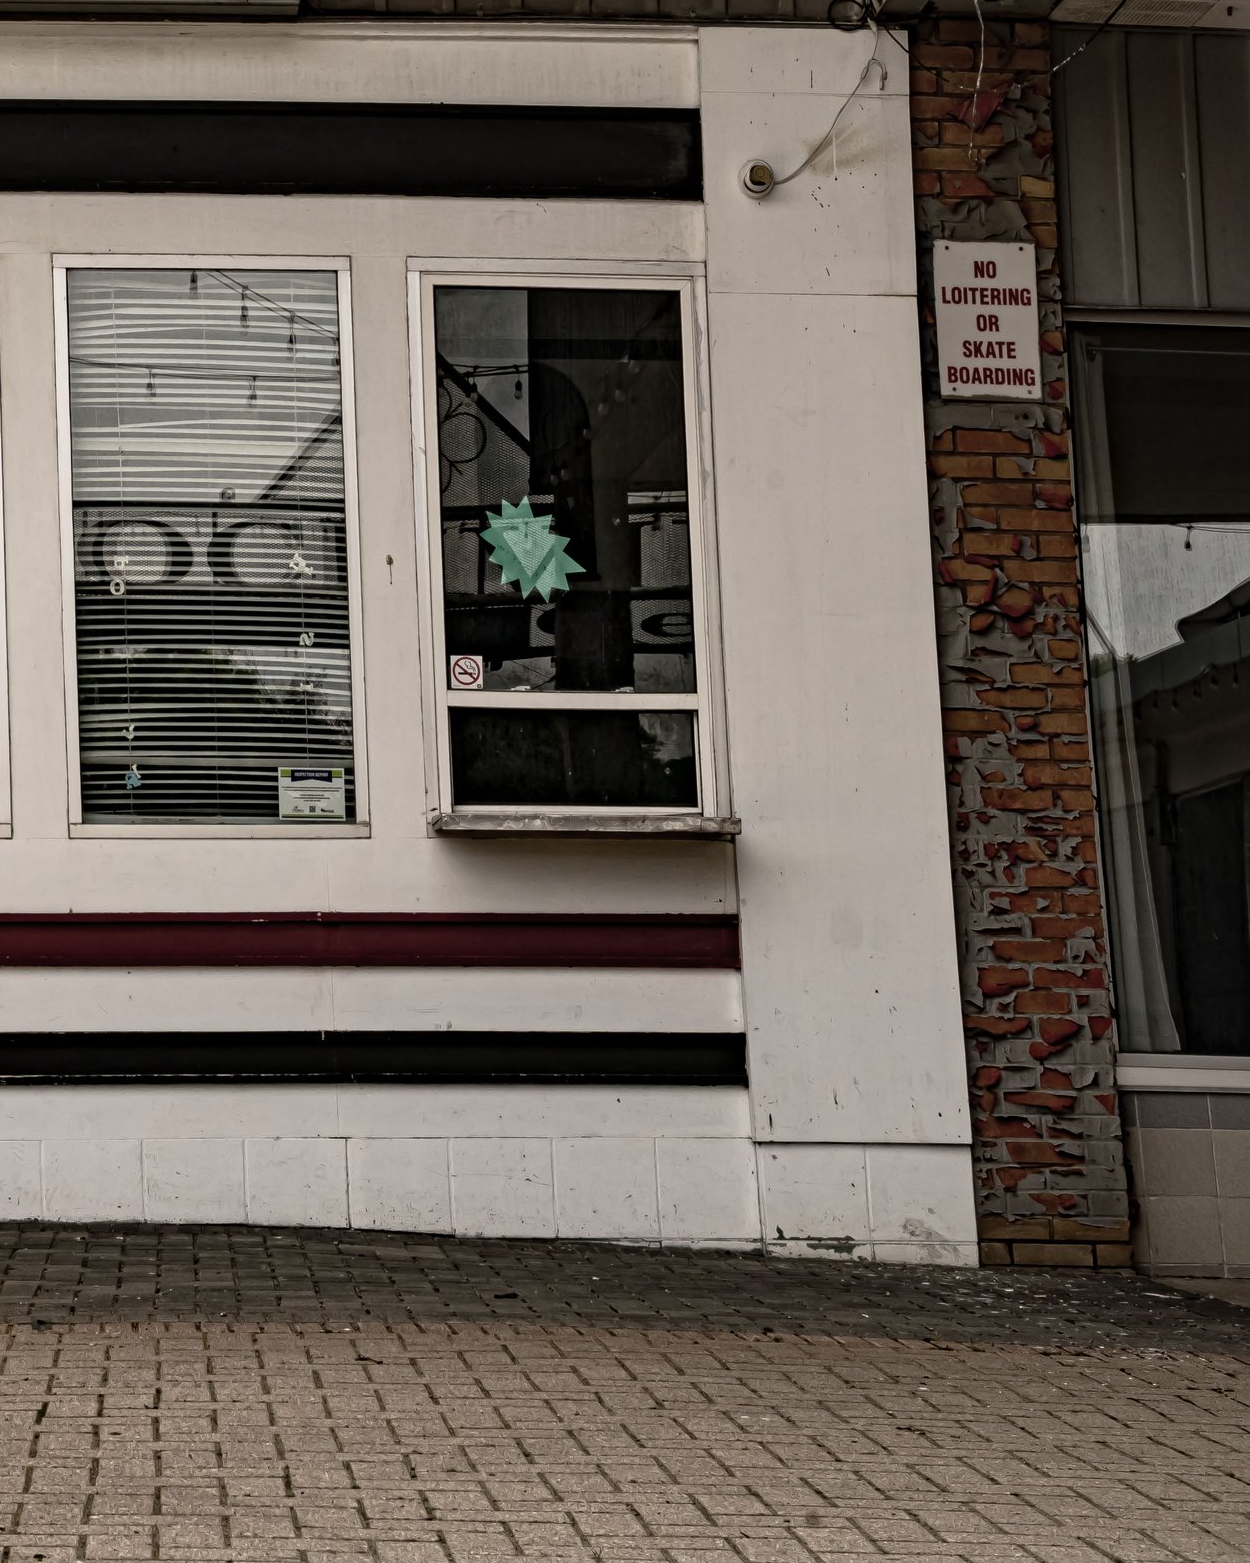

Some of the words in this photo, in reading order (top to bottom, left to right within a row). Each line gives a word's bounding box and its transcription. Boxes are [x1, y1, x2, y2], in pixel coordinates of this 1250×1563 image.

[973, 260, 997, 279] NO
[941, 286, 1032, 306] LOITERING
[976, 314, 1000, 332] OR
[962, 340, 1017, 359] SKATE
[947, 366, 1036, 386] BOARDING
